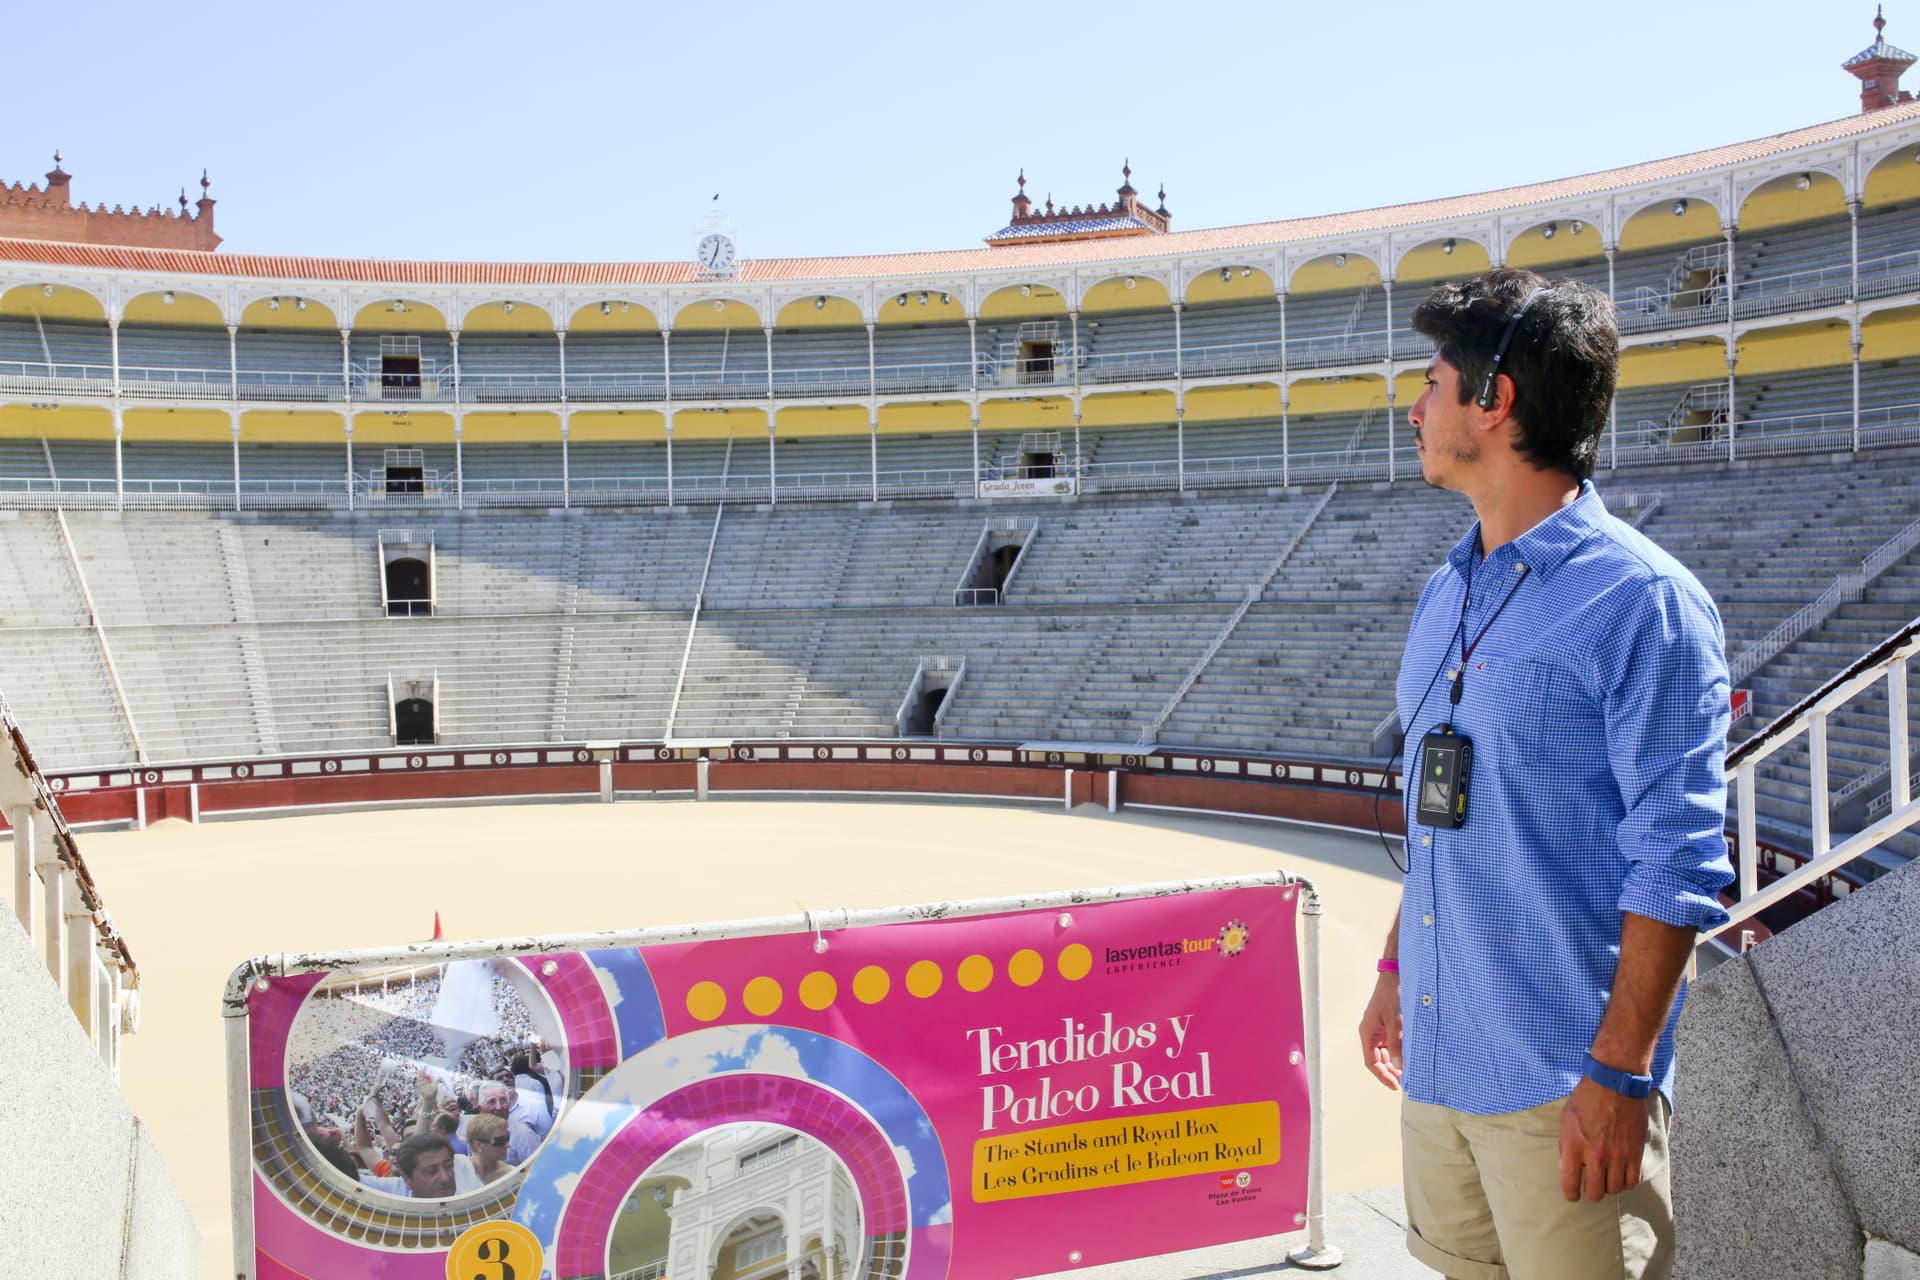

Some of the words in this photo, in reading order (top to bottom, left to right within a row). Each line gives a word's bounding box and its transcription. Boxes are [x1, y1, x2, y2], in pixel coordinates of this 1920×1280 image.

[966, 1012, 1157, 1076] Tendidos
[1165, 1014, 1194, 1058] y
[978, 1077, 1099, 1132] Palco
[1110, 1052, 1216, 1109] Real
[983, 1145, 1019, 1164] The
[1024, 1134, 1088, 1158] Stands
[1093, 1127, 1128, 1148] and
[1132, 1121, 1181, 1146] Royal
[1185, 1119, 1219, 1137] Box
[983, 1172, 1017, 1191] Les
[1021, 1162, 1098, 1186] Gradins
[1103, 1156, 1120, 1175] et
[1127, 1154, 1142, 1172] le
[1148, 1150, 1209, 1170] Balcon
[1214, 1138, 1263, 1163] Royal
[474, 1238, 515, 1280] 3
